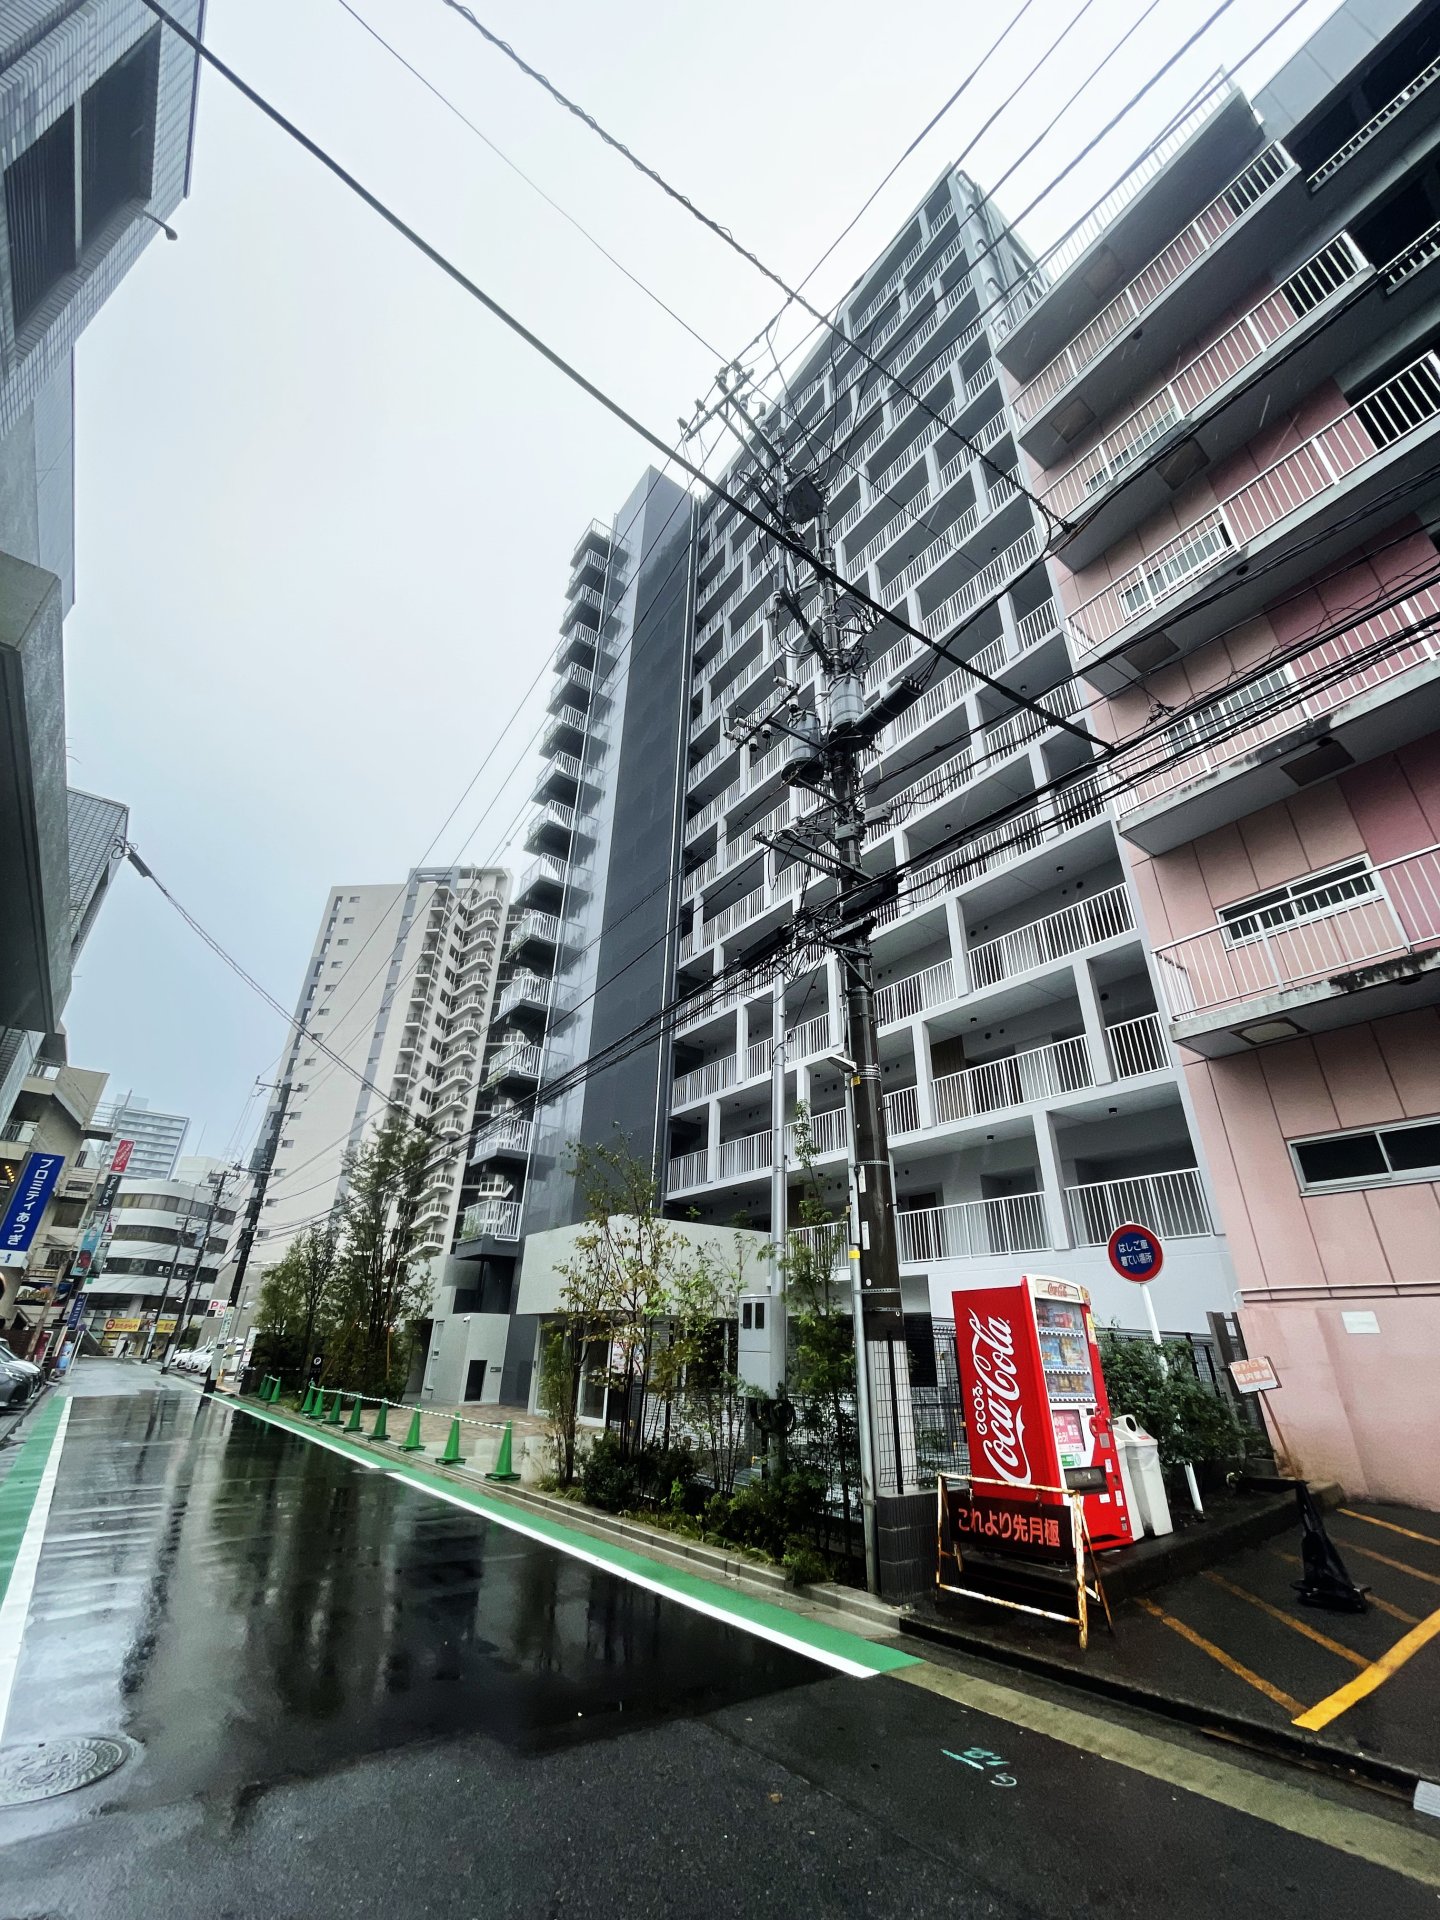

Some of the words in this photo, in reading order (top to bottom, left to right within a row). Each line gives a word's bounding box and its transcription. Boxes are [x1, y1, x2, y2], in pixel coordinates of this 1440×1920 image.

[967, 1308, 1032, 1484] Coca-Cola
[958, 1508, 1060, 1547] これより先月極
